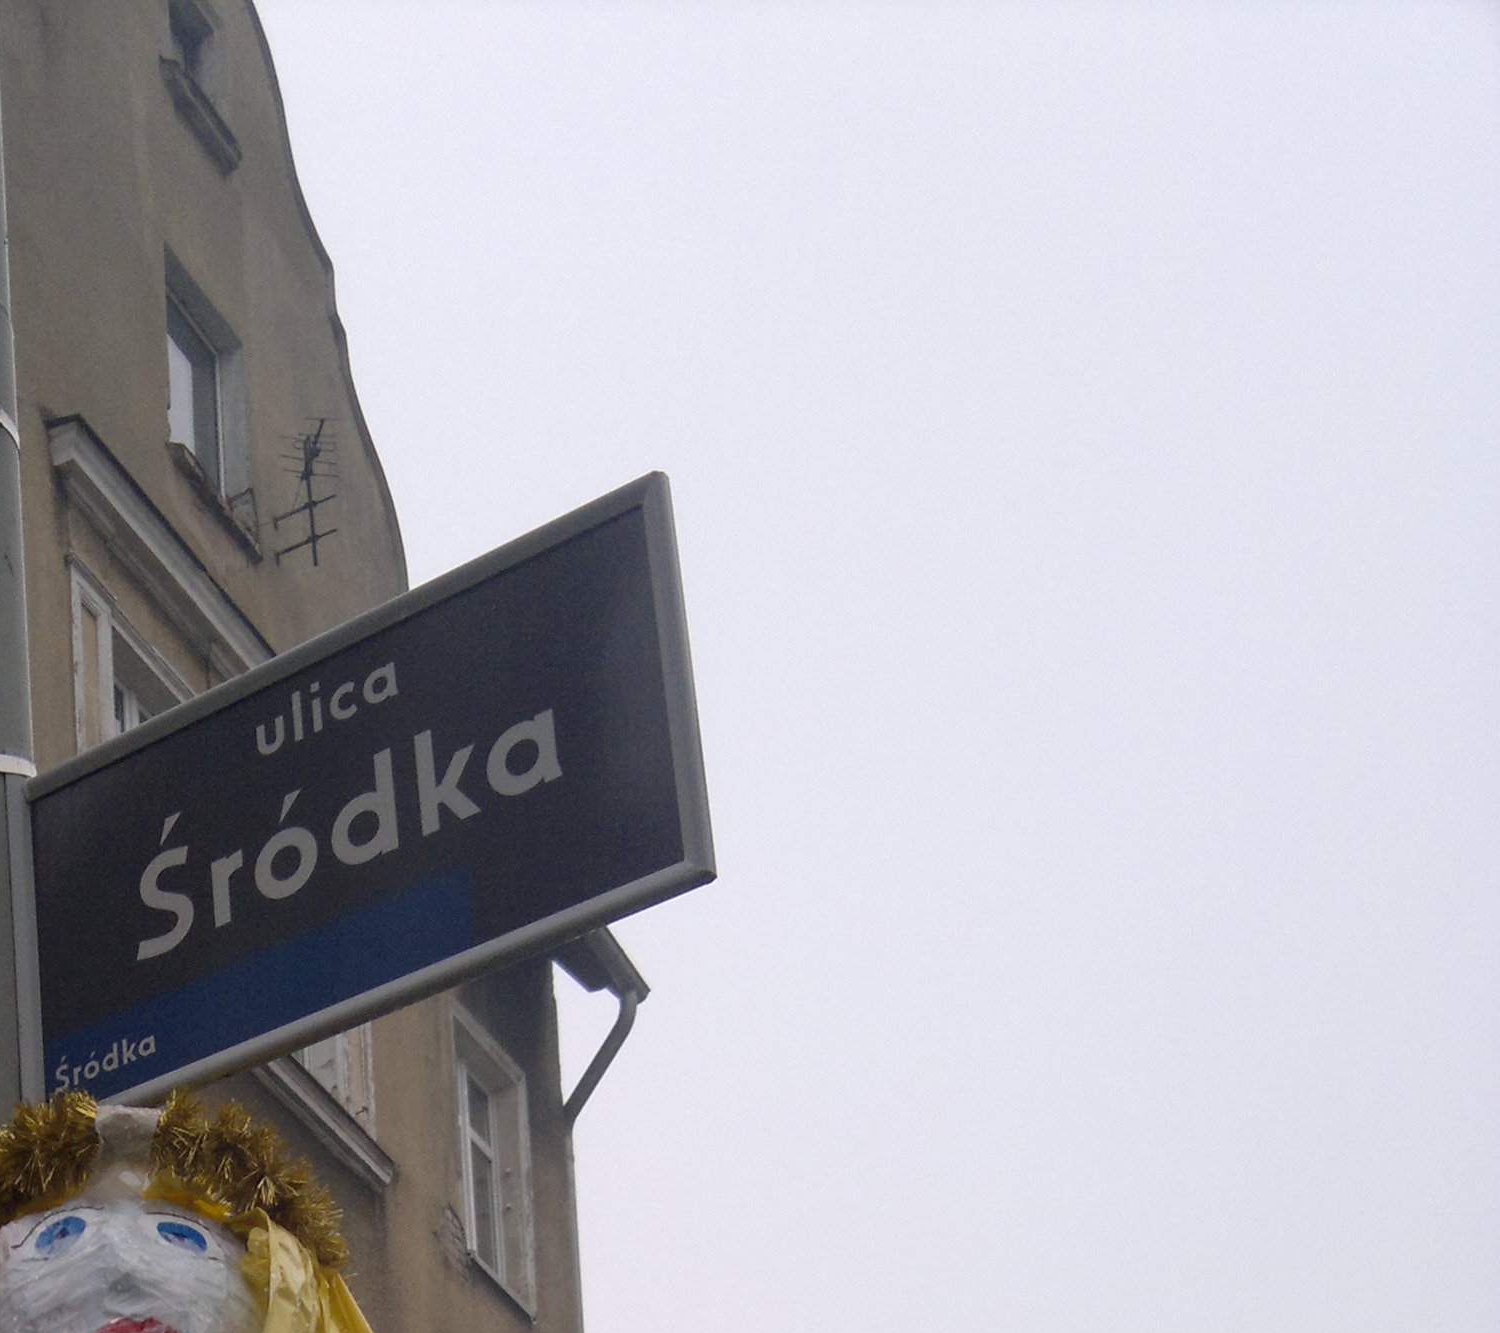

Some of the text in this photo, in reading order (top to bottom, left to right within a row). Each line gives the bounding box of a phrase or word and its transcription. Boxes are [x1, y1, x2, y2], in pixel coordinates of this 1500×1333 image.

[255, 661, 400, 756] ulica
[136, 708, 563, 961] Śródka
[53, 1034, 157, 1093] Śródka
